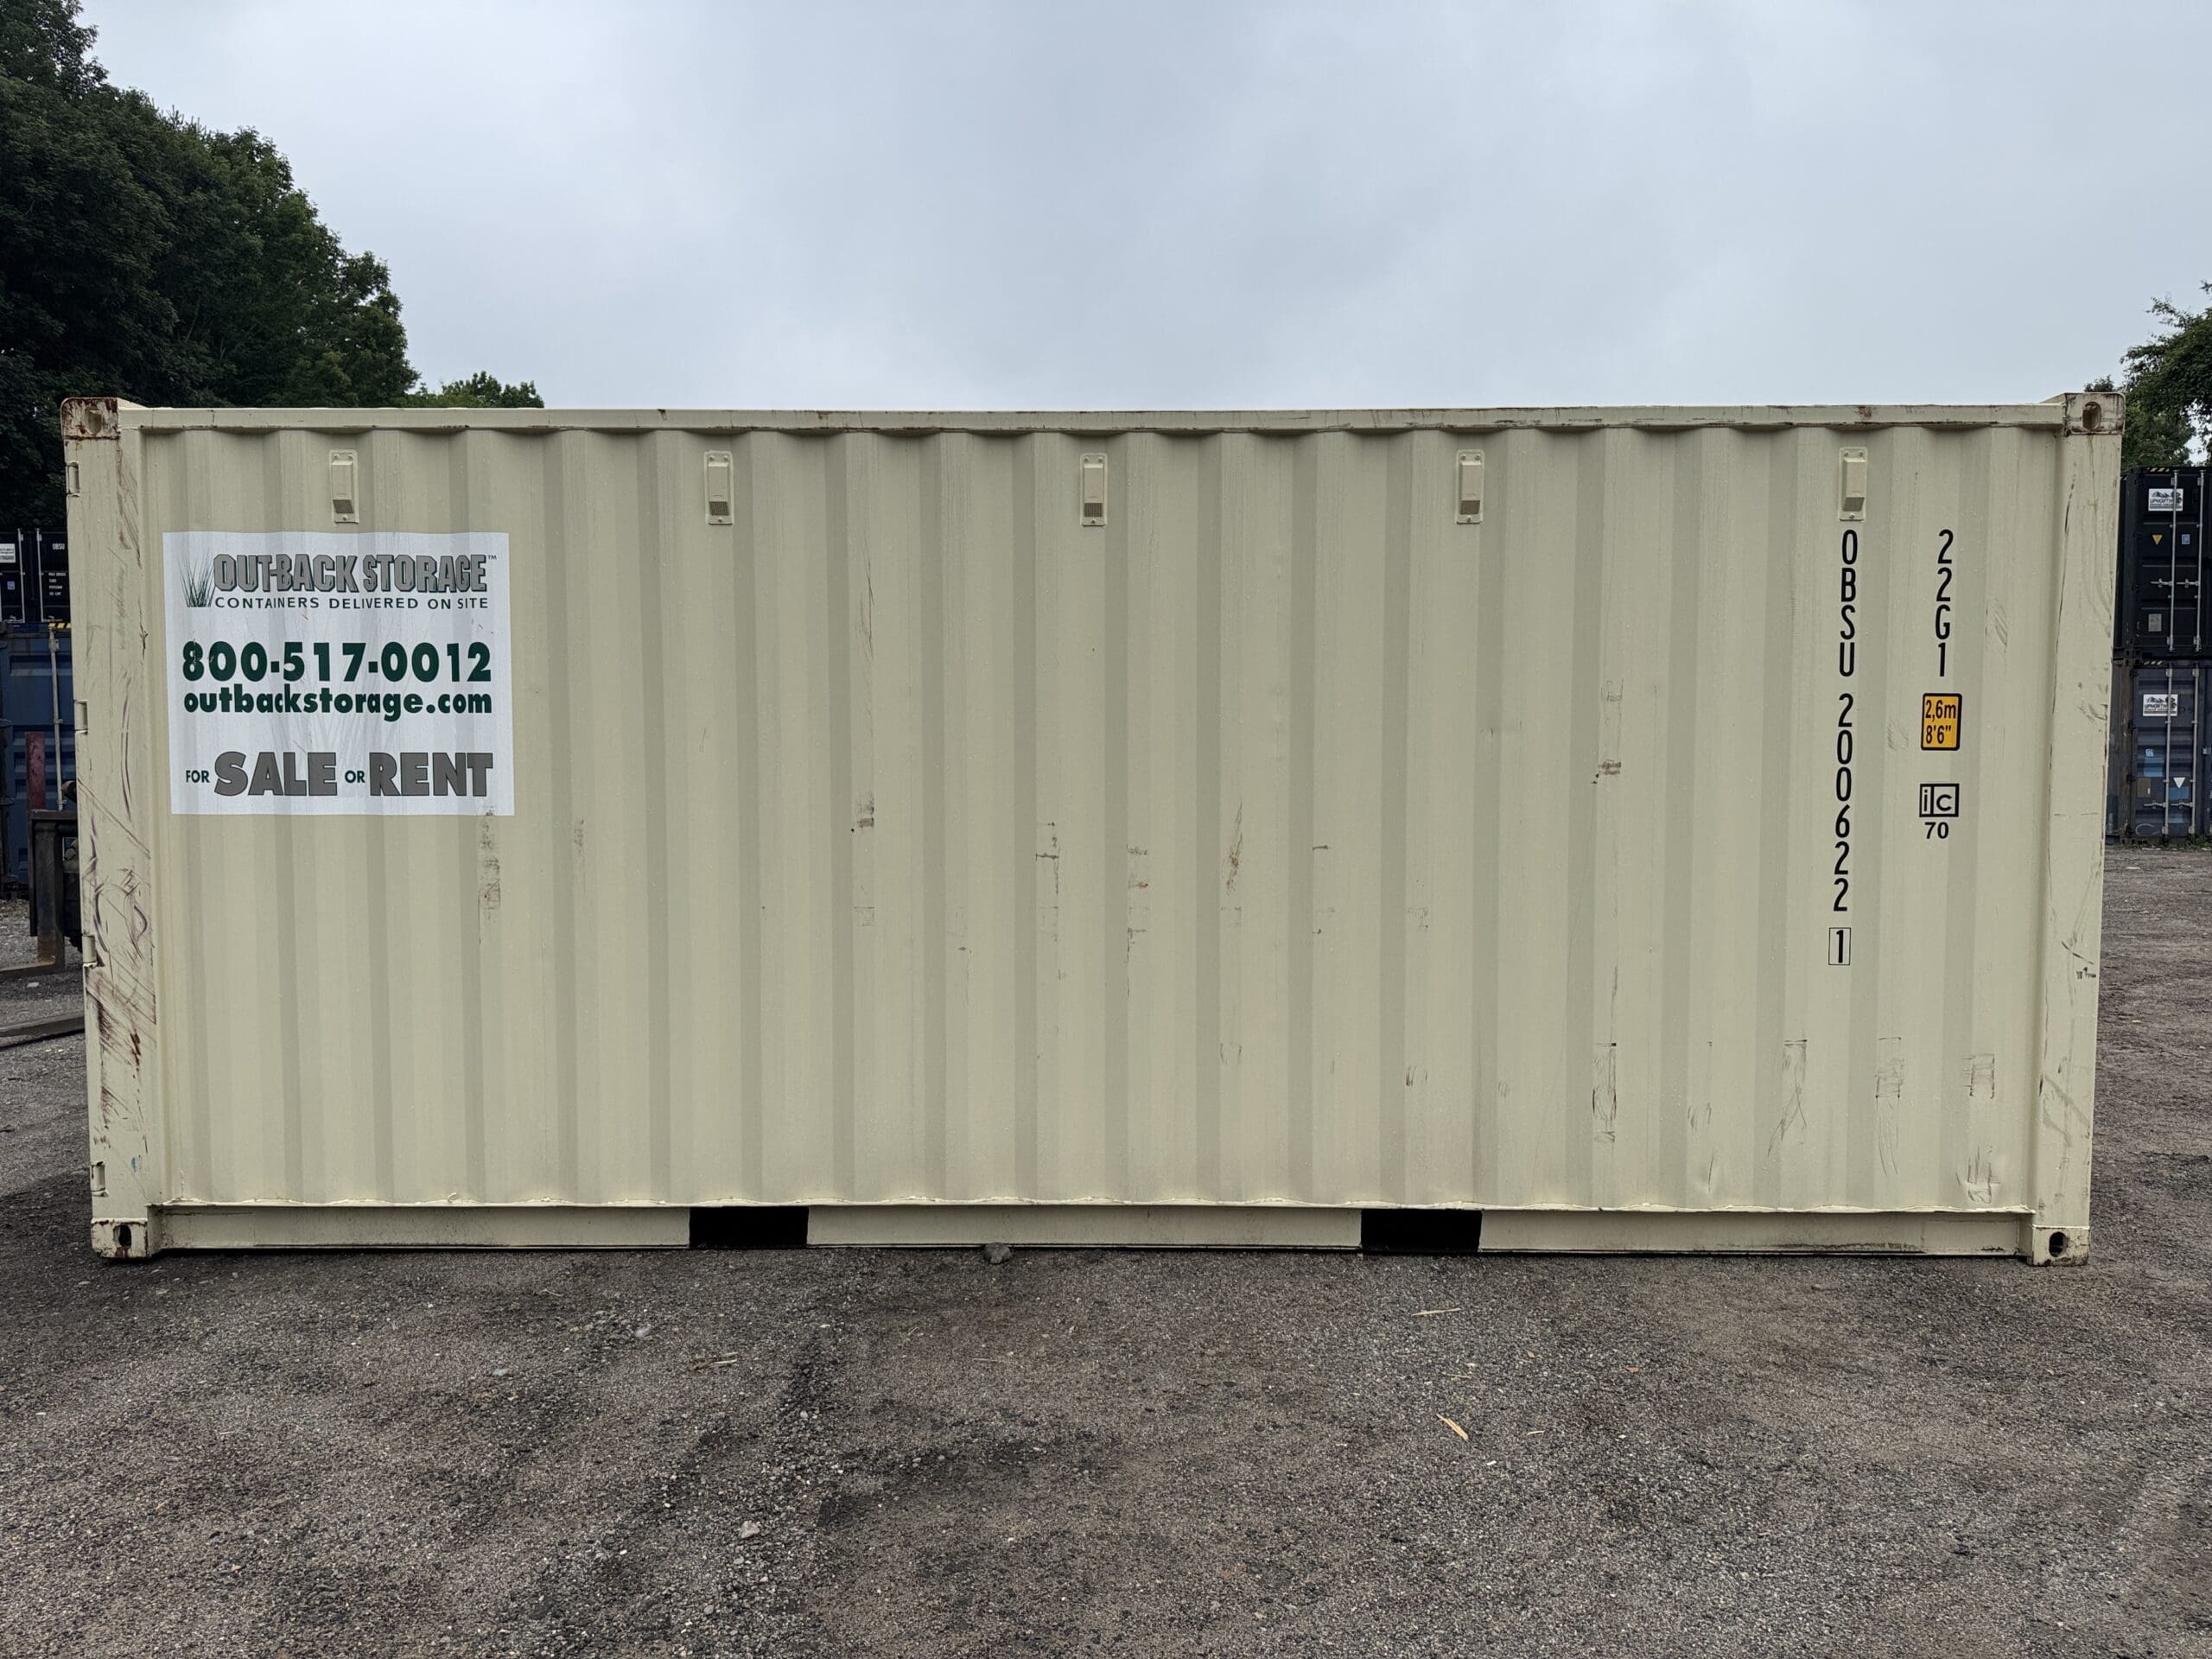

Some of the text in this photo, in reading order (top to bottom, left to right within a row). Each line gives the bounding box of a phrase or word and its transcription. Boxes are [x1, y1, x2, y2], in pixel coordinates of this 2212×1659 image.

[215, 597, 488, 609] CONTAINERS DELIVERED ON SITE
[1839, 529, 1858, 677] OBSU
[1935, 529, 1954, 677] 22G1
[184, 683, 492, 721] outbackstorage.com
[1925, 699, 1956, 721] 2,6m
[186, 751, 493, 797] FOR SALE OR RENT
[1833, 693, 1853, 911] 200622
[1924, 822, 1948, 839] 70
